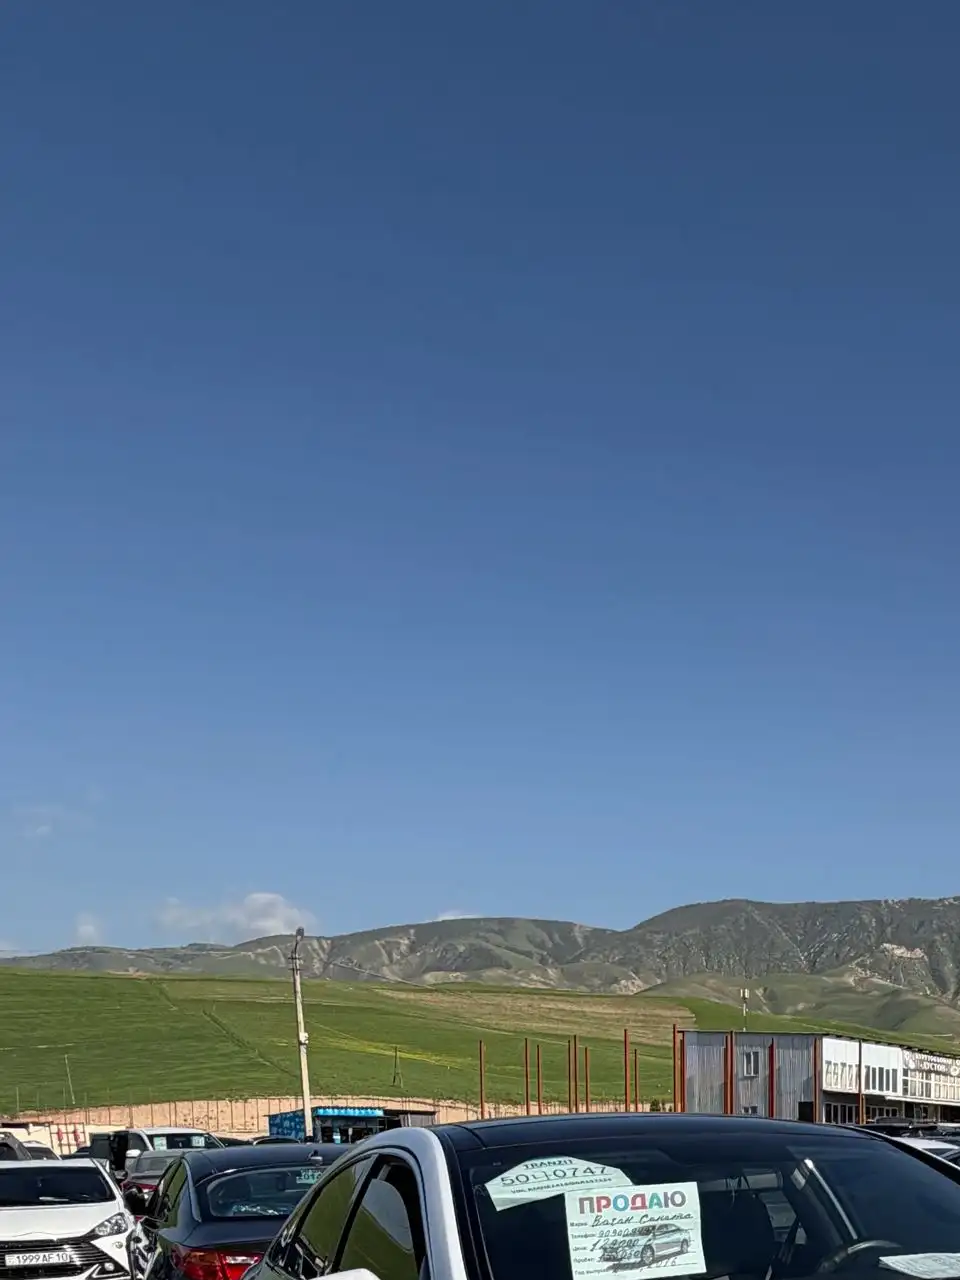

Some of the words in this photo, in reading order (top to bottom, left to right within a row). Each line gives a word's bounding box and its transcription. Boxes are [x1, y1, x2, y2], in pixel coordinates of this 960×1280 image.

[523, 1159, 574, 1170] TRANZIT
[578, 1190, 687, 1214] ПРОДАЮ
[16, 1254, 41, 1264] 1999
[56, 1252, 69, 1262] 10
